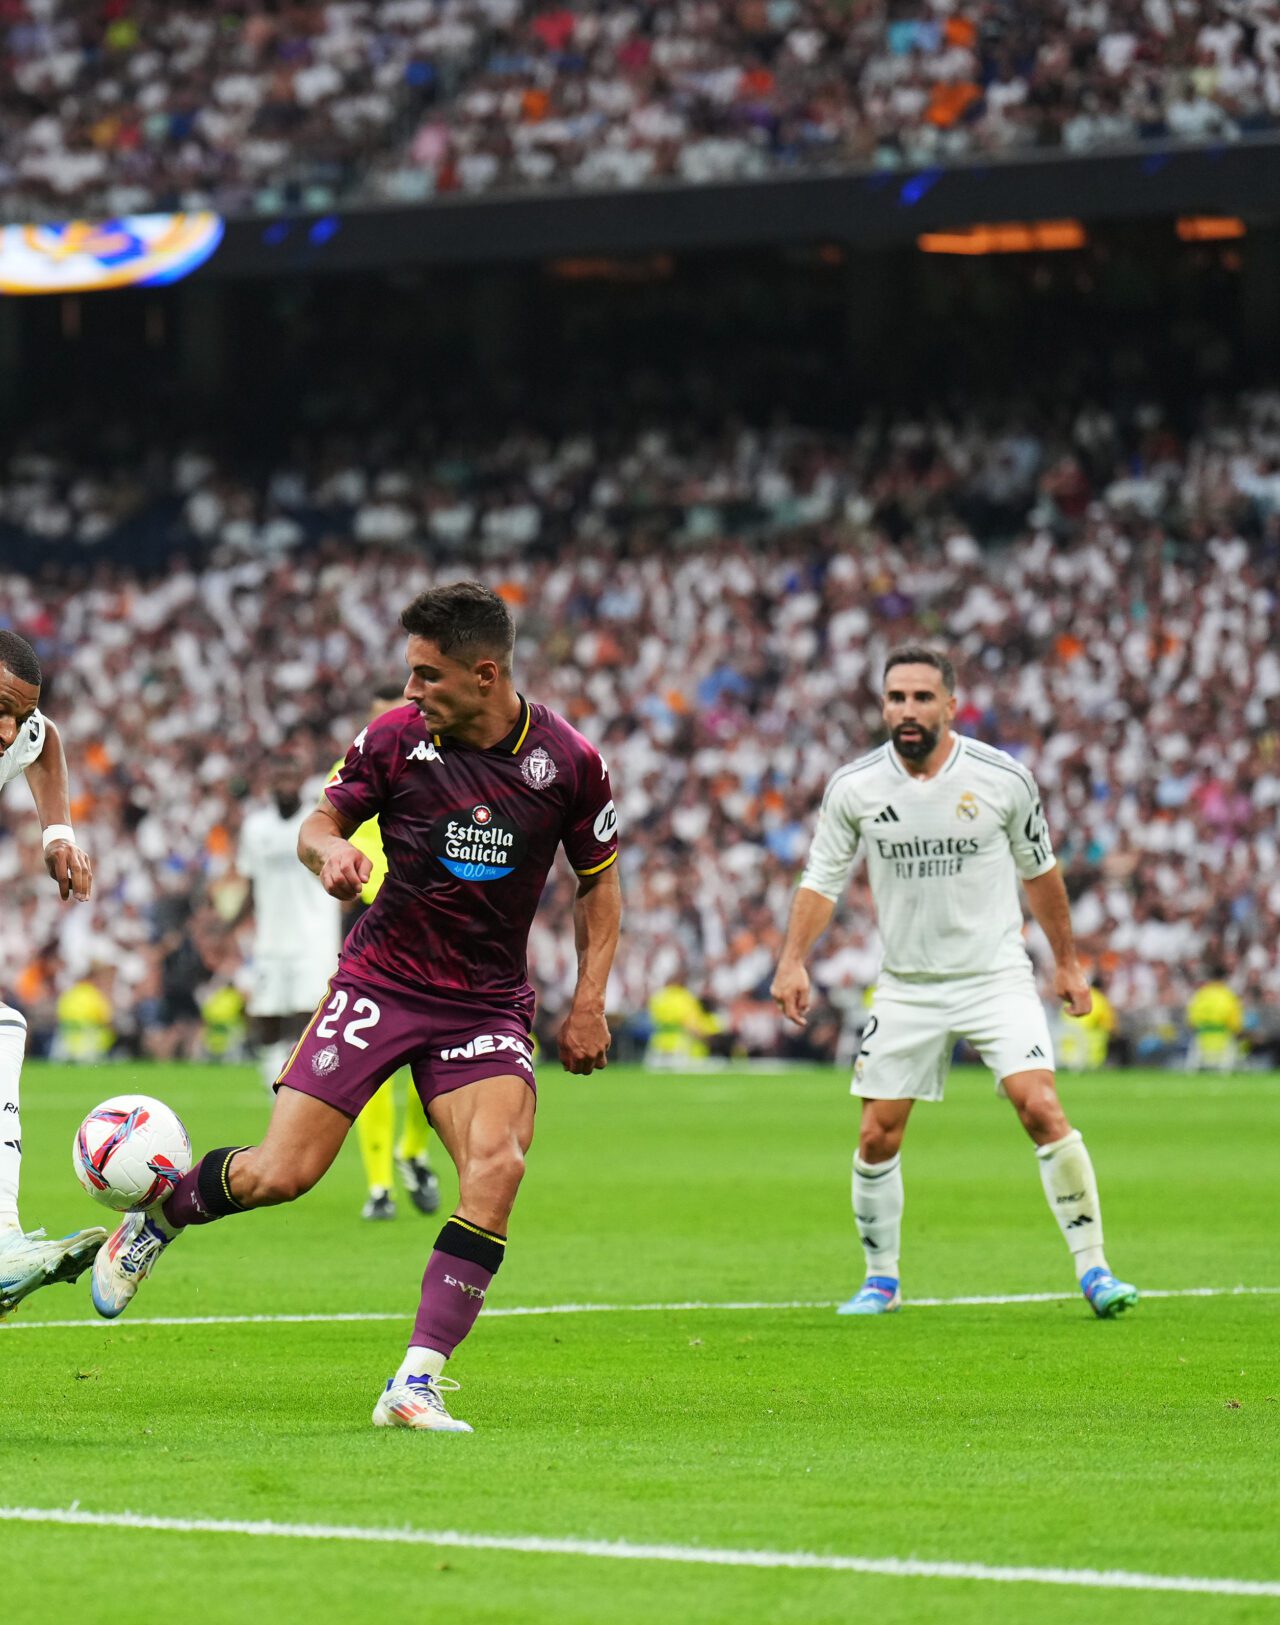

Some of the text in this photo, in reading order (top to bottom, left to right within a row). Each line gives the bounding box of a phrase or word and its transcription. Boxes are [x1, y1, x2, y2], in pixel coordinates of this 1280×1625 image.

[444, 820, 514, 847] Estrella
[598, 808, 617, 835] JD
[445, 839, 508, 864] Galicia
[876, 835, 979, 860] Emirates
[895, 857, 963, 879] FLY BETTER
[316, 990, 380, 1050] 22
